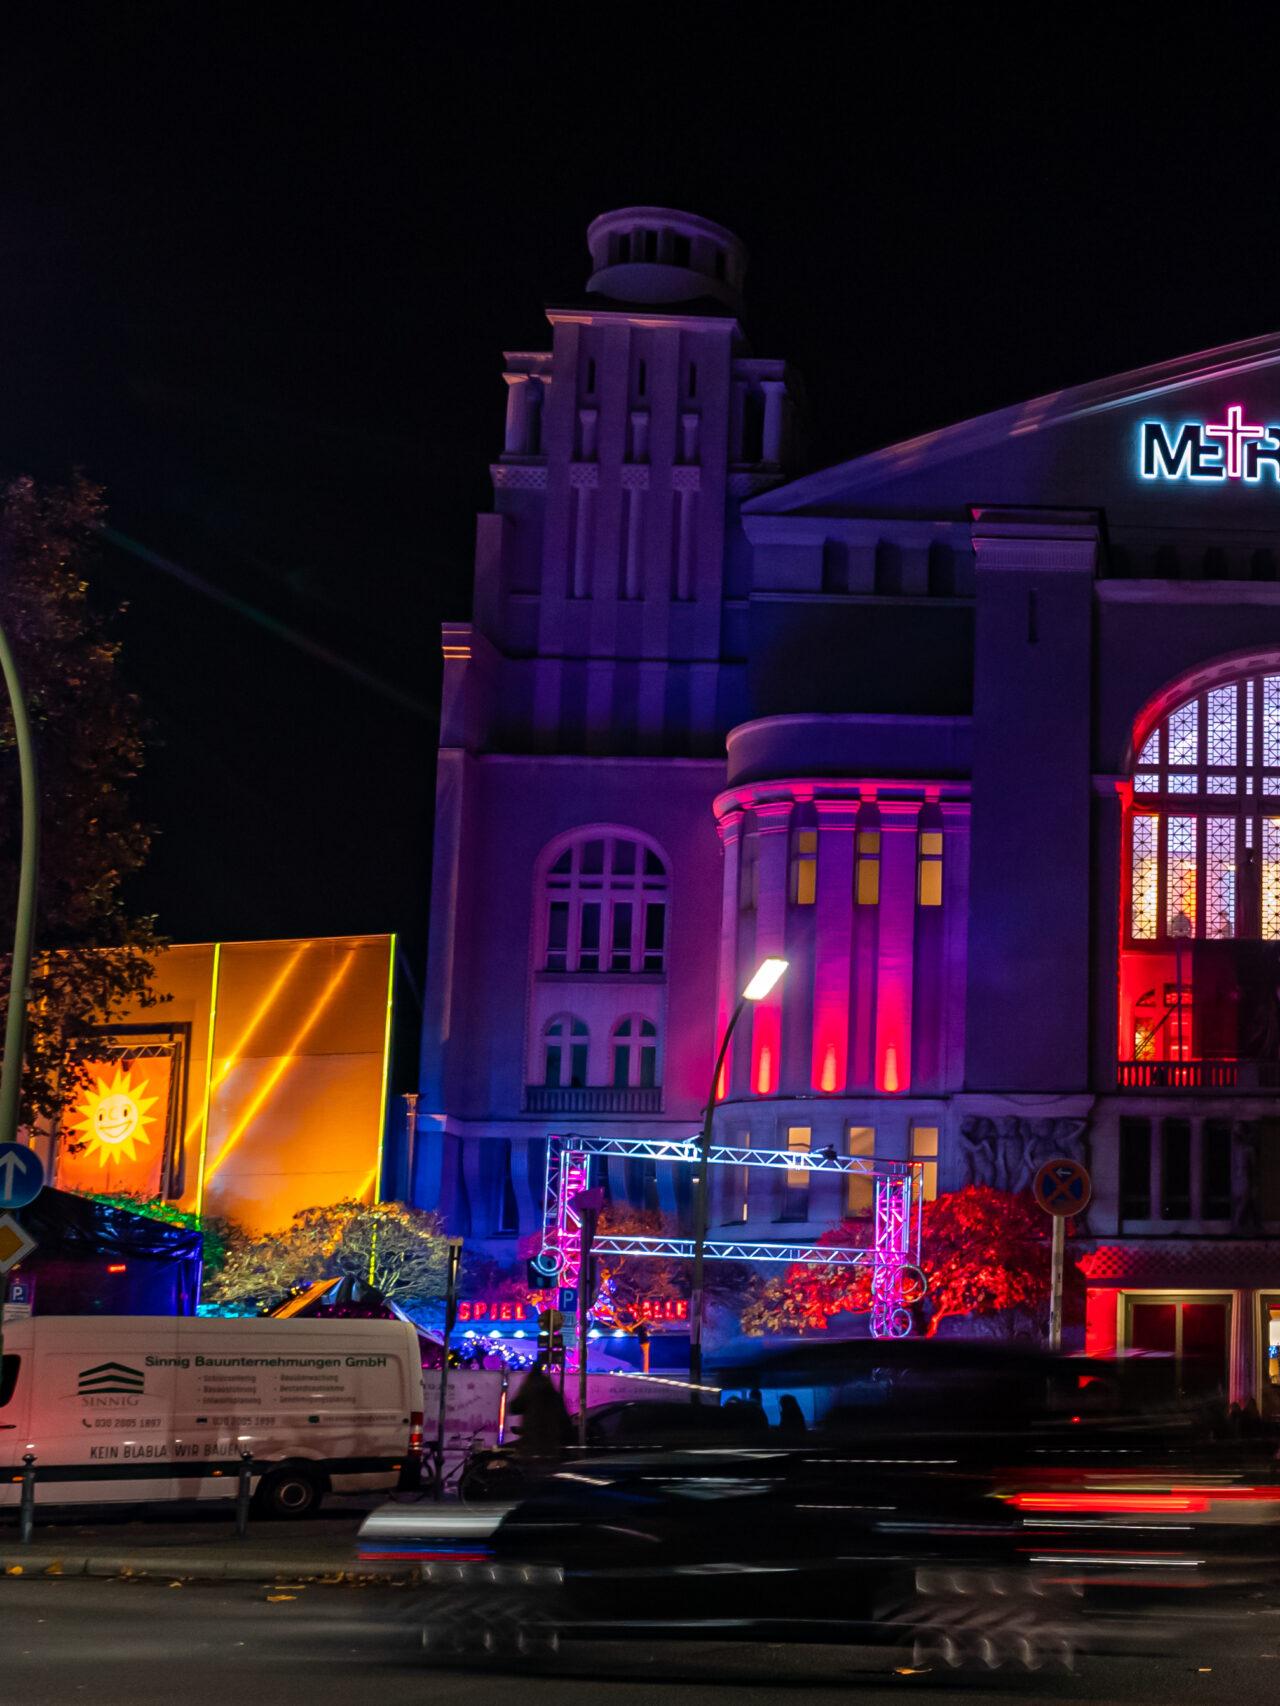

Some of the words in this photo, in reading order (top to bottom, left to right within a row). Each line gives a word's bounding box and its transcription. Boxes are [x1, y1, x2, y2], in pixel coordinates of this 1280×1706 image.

[562, 1289, 574, 1309] P
[458, 1301, 527, 1321] SPIEL
[144, 1355, 191, 1369] Sinnig
[194, 1355, 341, 1369] Bauunternehmungen
[345, 1356, 387, 1368] GmbH
[80, 1394, 140, 1407] SINNIG
[94, 1418, 112, 1429] 030
[90, 1445, 119, 1459] KEIN
[123, 1444, 168, 1458] BLABLA
[175, 1444, 200, 1457] WIR
